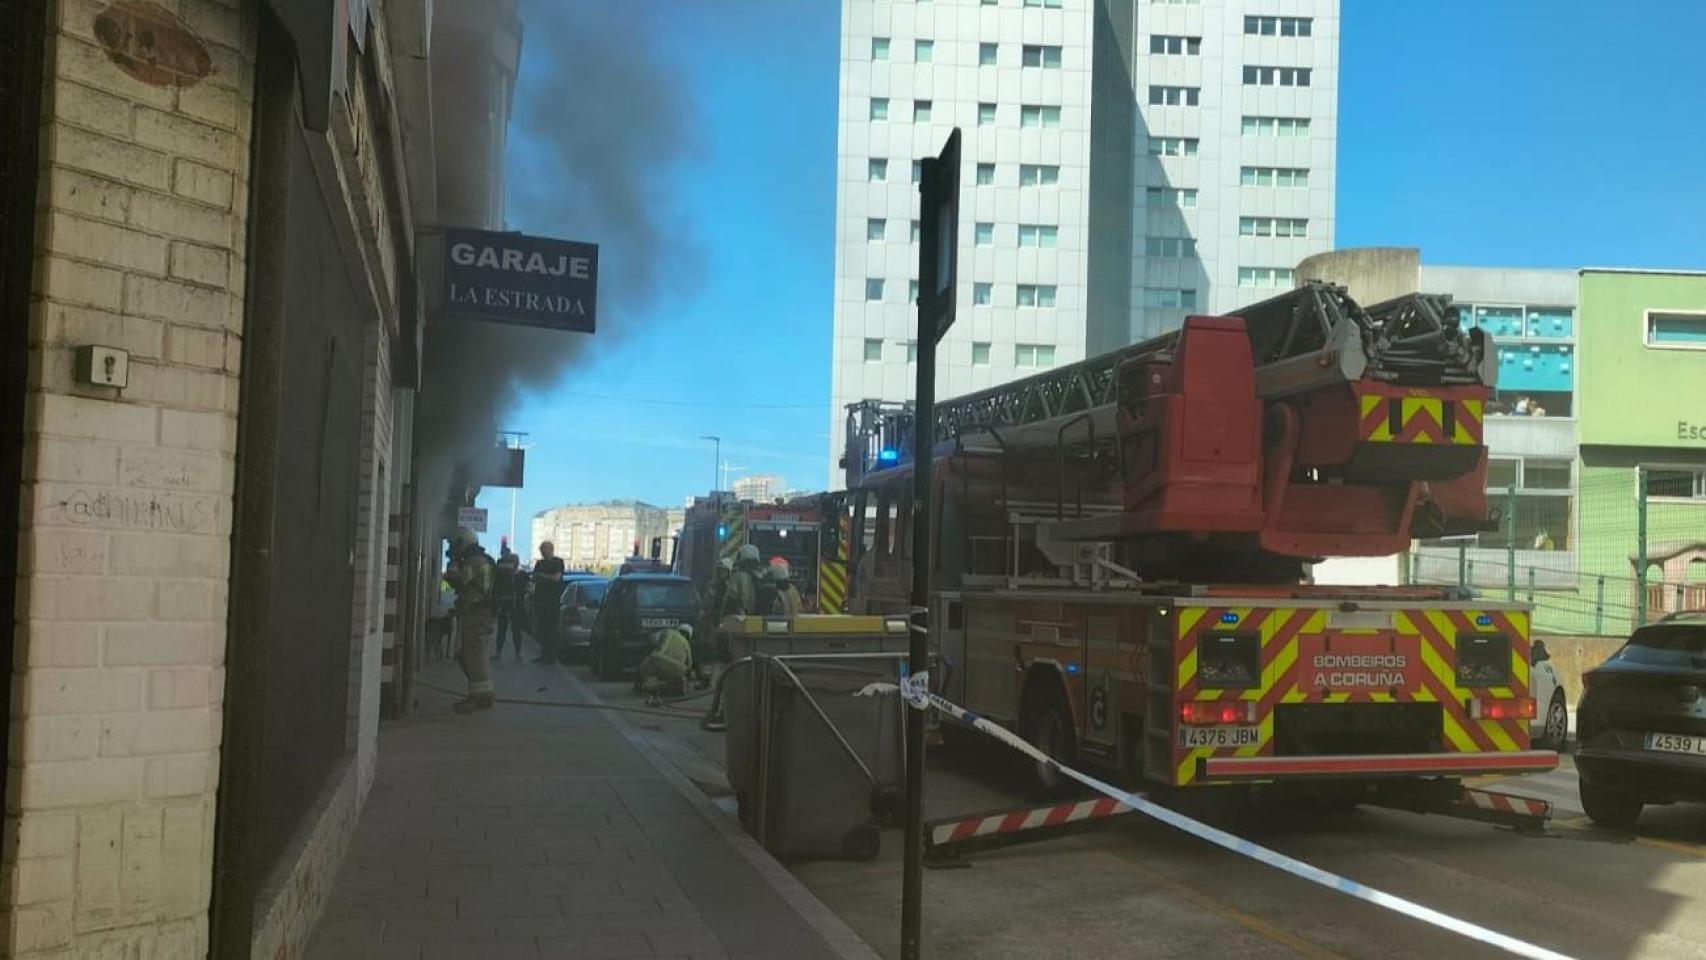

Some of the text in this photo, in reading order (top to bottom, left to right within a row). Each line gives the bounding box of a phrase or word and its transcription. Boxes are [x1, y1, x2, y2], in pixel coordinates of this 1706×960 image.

[451, 243, 589, 279] GARAJE
[450, 283, 586, 315] LA ESTRADA
[1313, 655, 1407, 668] BOMBEIROS
[1314, 669, 1405, 687] A CORUÑA
[1190, 728, 1259, 745] 4376 JBM
[1655, 735, 1691, 751] 4539
